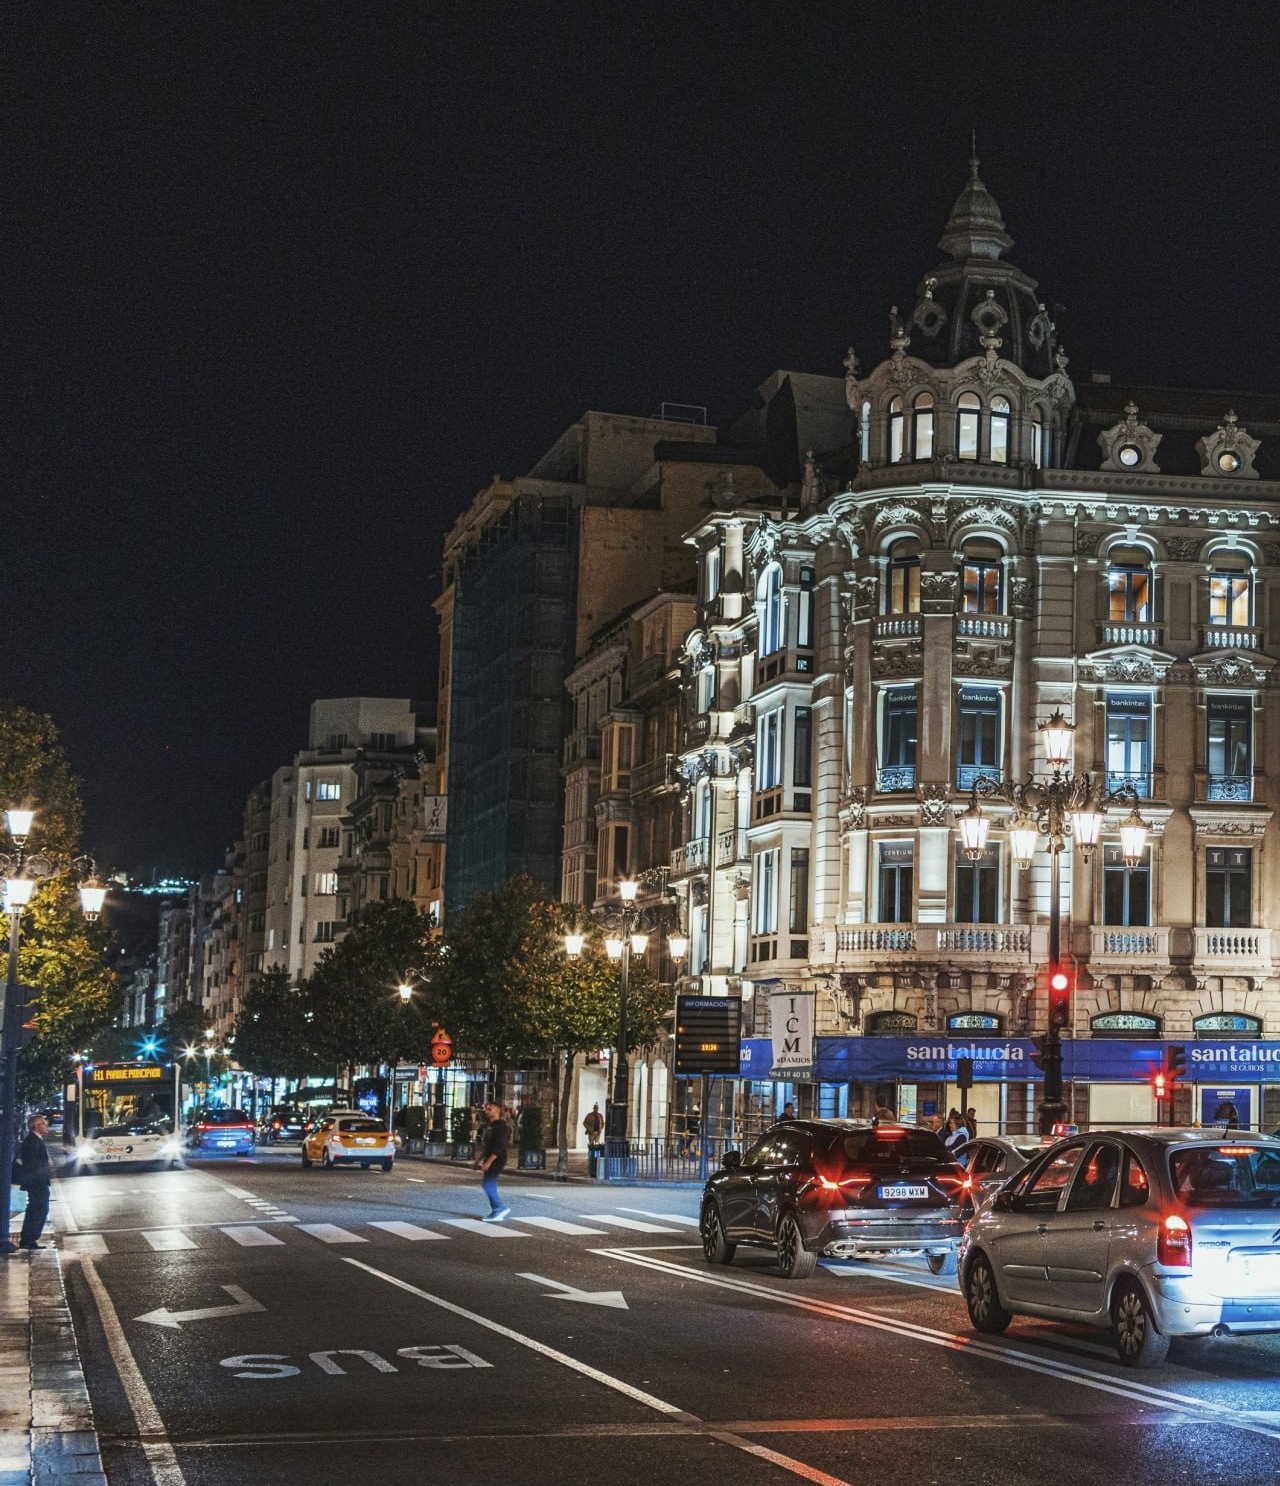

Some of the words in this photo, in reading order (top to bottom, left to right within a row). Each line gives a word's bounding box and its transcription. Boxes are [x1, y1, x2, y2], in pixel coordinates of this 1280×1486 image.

[962, 694, 996, 702] bankinter
[1111, 699, 1146, 707] bankinter
[684, 1000, 729, 1008] INFORMACIÓN
[906, 1043, 1024, 1060] santalucía
[1230, 1064, 1265, 1072] SEGUROS
[884, 1188, 907, 1197] 9298
[909, 1188, 925, 1196] MXM
[219, 1344, 495, 1379] BUS
